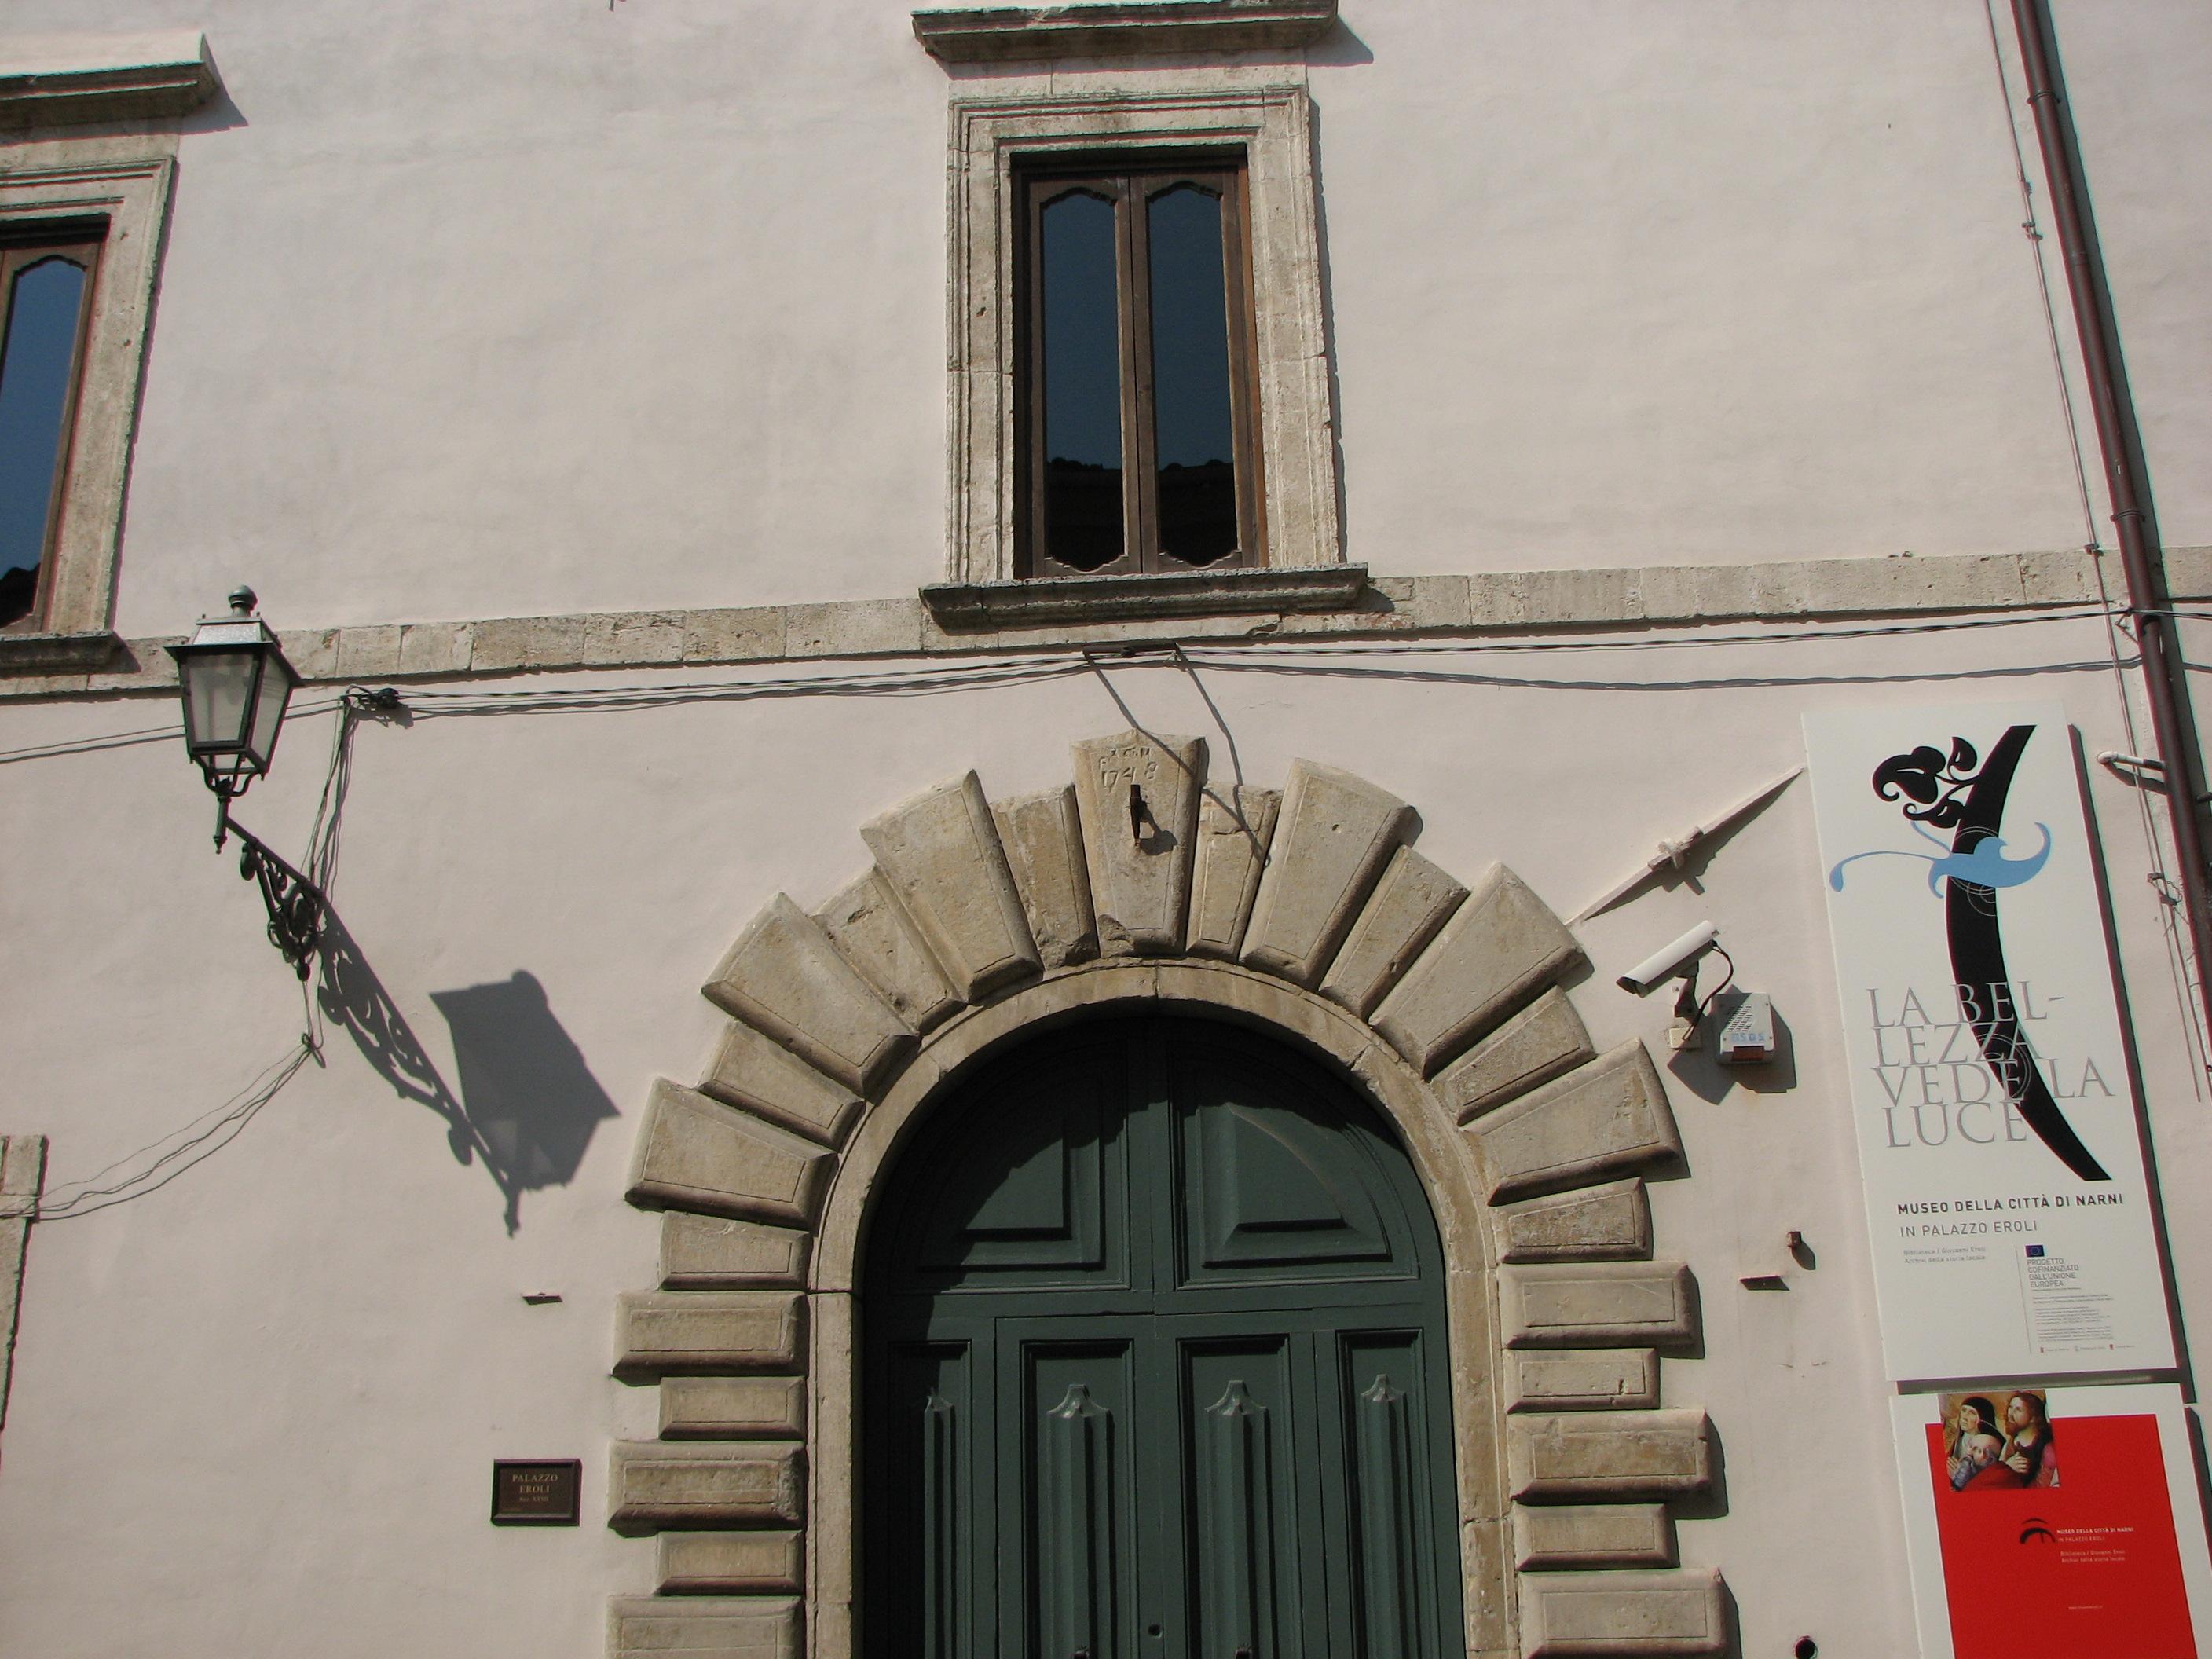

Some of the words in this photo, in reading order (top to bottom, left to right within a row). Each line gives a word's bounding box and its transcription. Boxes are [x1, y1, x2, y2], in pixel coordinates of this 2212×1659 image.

[1866, 987, 1935, 1028] LA
[1950, 981, 2065, 1024] BEL-
[1870, 1020, 2043, 1068] LEZZA
[1871, 1060, 2025, 1107] VEDE
[2045, 1057, 2116, 1099] LA
[1882, 1101, 2027, 1148] LUCE
[1898, 1202, 1948, 1215] MUSEO
[1954, 1199, 2003, 1212] DELLA
[2009, 1194, 2050, 1210] CITTÀ
[2055, 1196, 2070, 1207] DI
[2076, 1193, 2123, 1206] NARNI
[1900, 1225, 1916, 1237] IN
[1922, 1221, 1987, 1236] PALAZZO
[1994, 1220, 2038, 1233] EROLI
[2027, 1264, 2079, 1273] COFINANZIATO
[2030, 1280, 2064, 1288] EUROPEA
[511, 1474, 558, 1483] PALAZZO
[519, 1485, 550, 1494] EROLI
